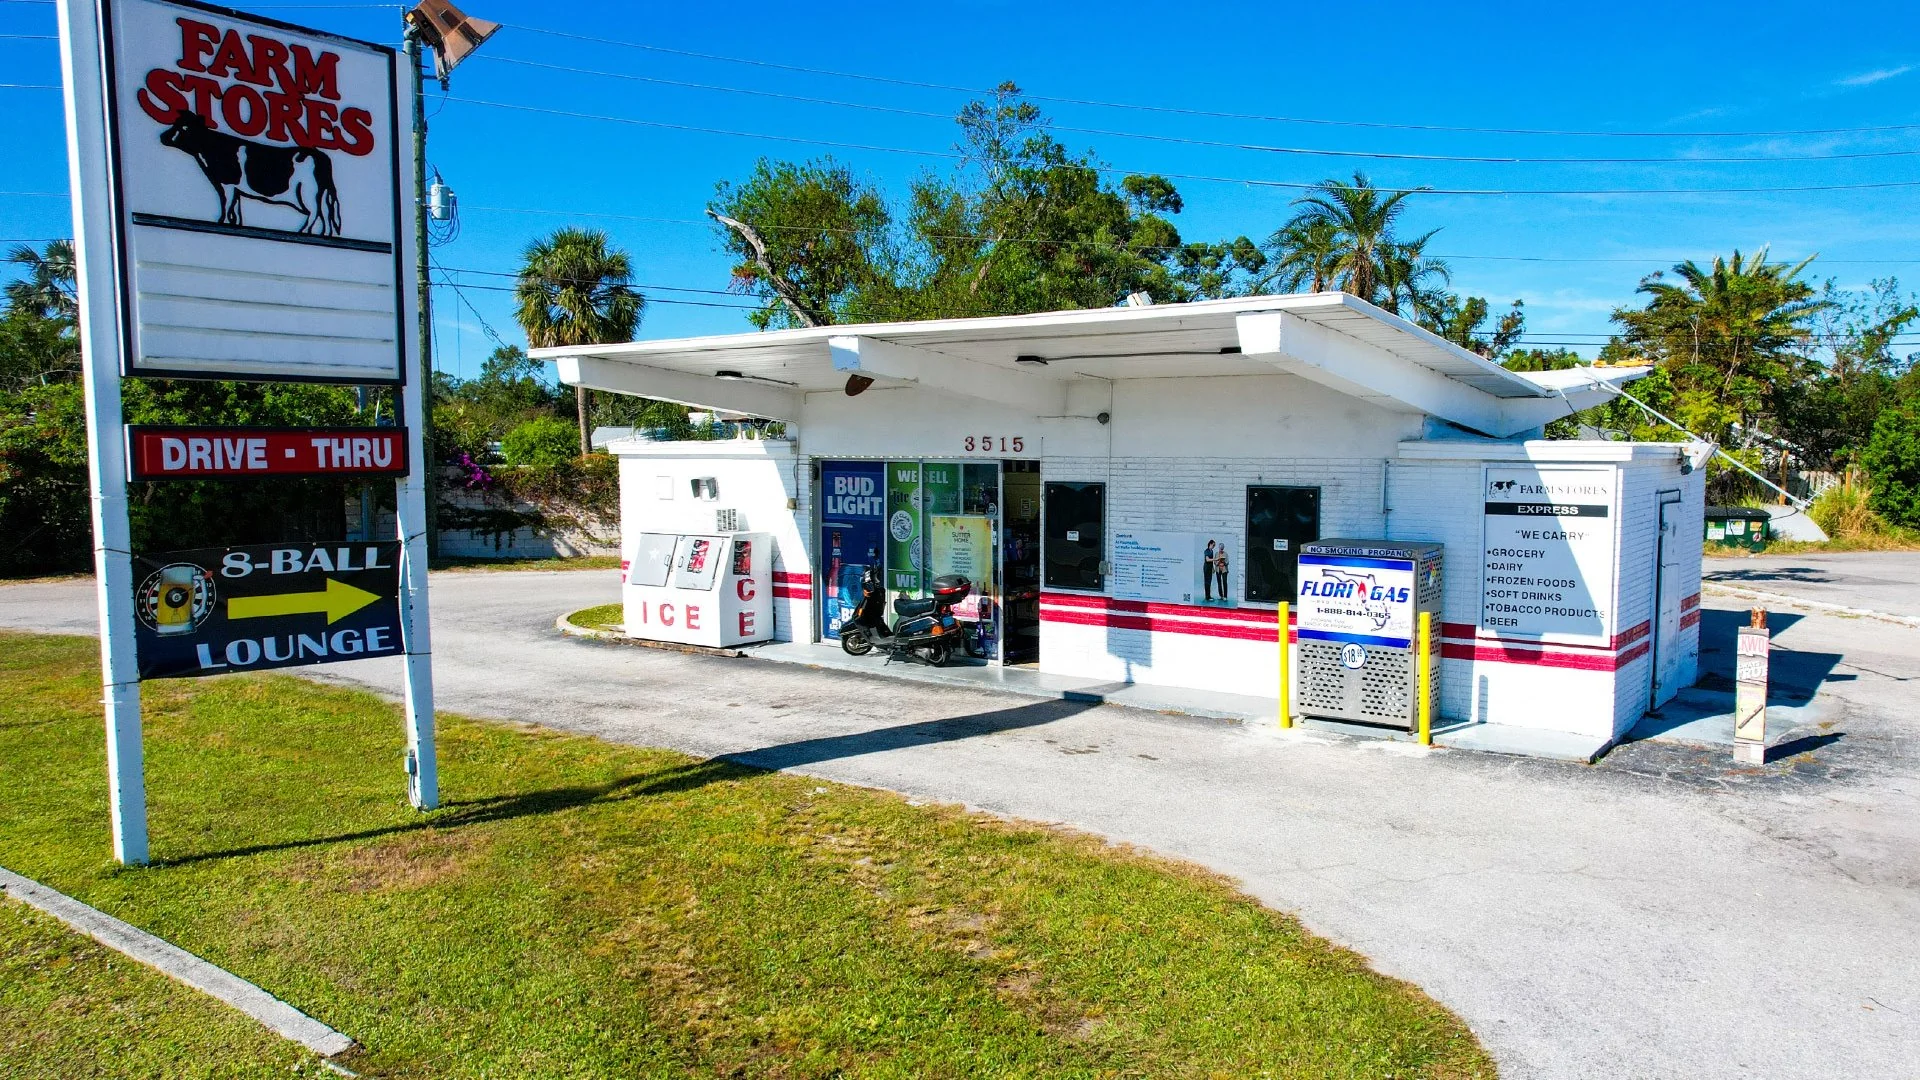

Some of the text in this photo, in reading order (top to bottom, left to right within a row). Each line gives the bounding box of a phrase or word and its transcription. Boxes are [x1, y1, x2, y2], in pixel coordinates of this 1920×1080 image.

[176, 17, 342, 101] FARM
[137, 68, 375, 157] STORES
[964, 436, 1024, 453] 3515
[161, 437, 268, 471] DRIVE
[311, 437, 393, 468] THRU
[897, 470, 918, 483] WE
[834, 476, 875, 496] BUD
[827, 495, 882, 516] LIGHT
[1517, 505, 1579, 515] EXPRESS
[1325, 547, 1364, 555] SMOKING
[1491, 549, 1545, 559] GROCERY
[221, 546, 391, 578] 8-BALL
[1491, 562, 1523, 572] DAIRY
[895, 574, 917, 588] WE
[1491, 576, 1576, 588] FROZEN FOODS
[1300, 580, 1411, 603] FLORI GAS
[1490, 590, 1562, 602] SOFT DRINKS
[642, 601, 700, 630] ICE
[1489, 603, 1605, 619] TOBACCO PRODUCTS
[1489, 617, 1518, 627] BEER
[197, 625, 396, 669] LOUNGE
